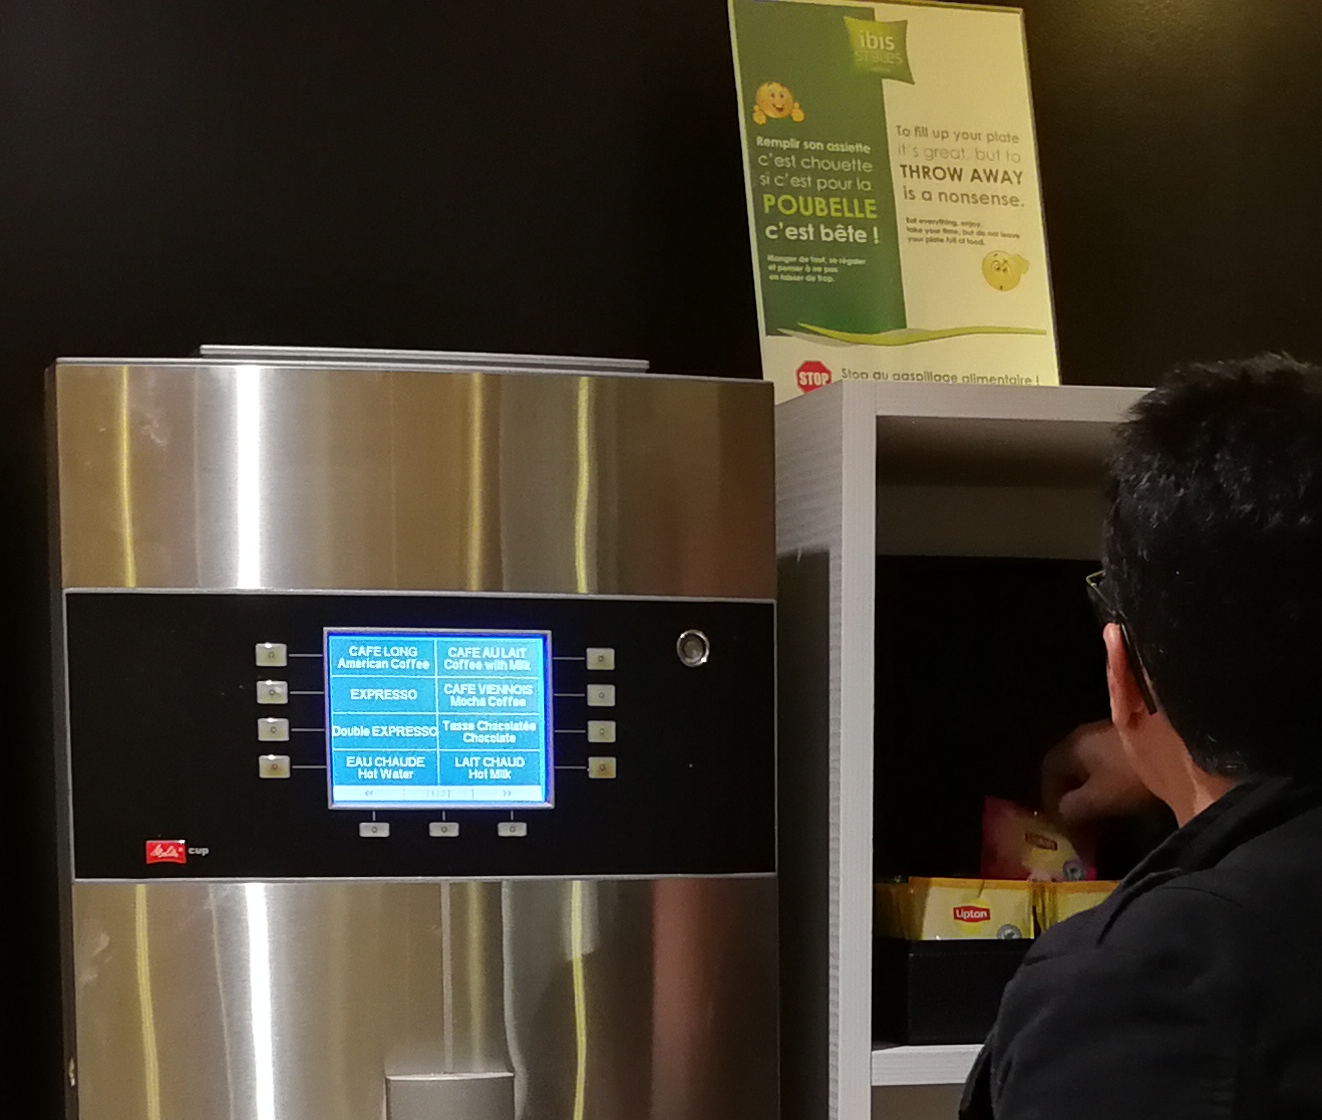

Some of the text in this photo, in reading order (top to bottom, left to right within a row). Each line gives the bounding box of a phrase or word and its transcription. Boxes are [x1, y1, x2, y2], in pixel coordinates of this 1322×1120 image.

[860, 30, 895, 51] ibis
[896, 125, 1019, 144] To fill up your plate
[756, 136, 871, 154] Remplir son assiette
[898, 143, 919, 157] it's
[975, 147, 1000, 161] but
[1006, 148, 1021, 163] to
[758, 152, 873, 173] c'est chouette
[900, 164, 1023, 185] THROW AWAY
[759, 172, 872, 191] si c'est pour la
[903, 185, 1025, 207] is a nonsense.
[763, 193, 878, 219] POUBELLE
[765, 221, 879, 244] c'est bête !
[799, 371, 829, 386] STOP
[872, 371, 889, 380] au
[892, 371, 958, 383] gaspillage
[962, 373, 1032, 385] alimentaire
[348, 646, 418, 657] CAFE LONG
[448, 647, 527, 659] CAFE AU LAIT
[337, 657, 430, 669] American Coffee
[444, 659, 531, 671] Coffee with Milk
[350, 689, 417, 700] EXPRESSO
[444, 684, 533, 695] CAFE VIENNOIS
[450, 695, 526, 707] Mocha Coffee
[332, 725, 437, 737] Double EXPRESSO
[463, 733, 517, 744] Chocolate
[346, 756, 425, 767] EAU CHAUDE
[455, 756, 525, 768] LAIT CHAUD
[358, 769, 414, 780] Hot Water
[469, 769, 512, 780] Hot Milk
[188, 847, 209, 856] cup
[956, 908, 987, 920] Lipton
